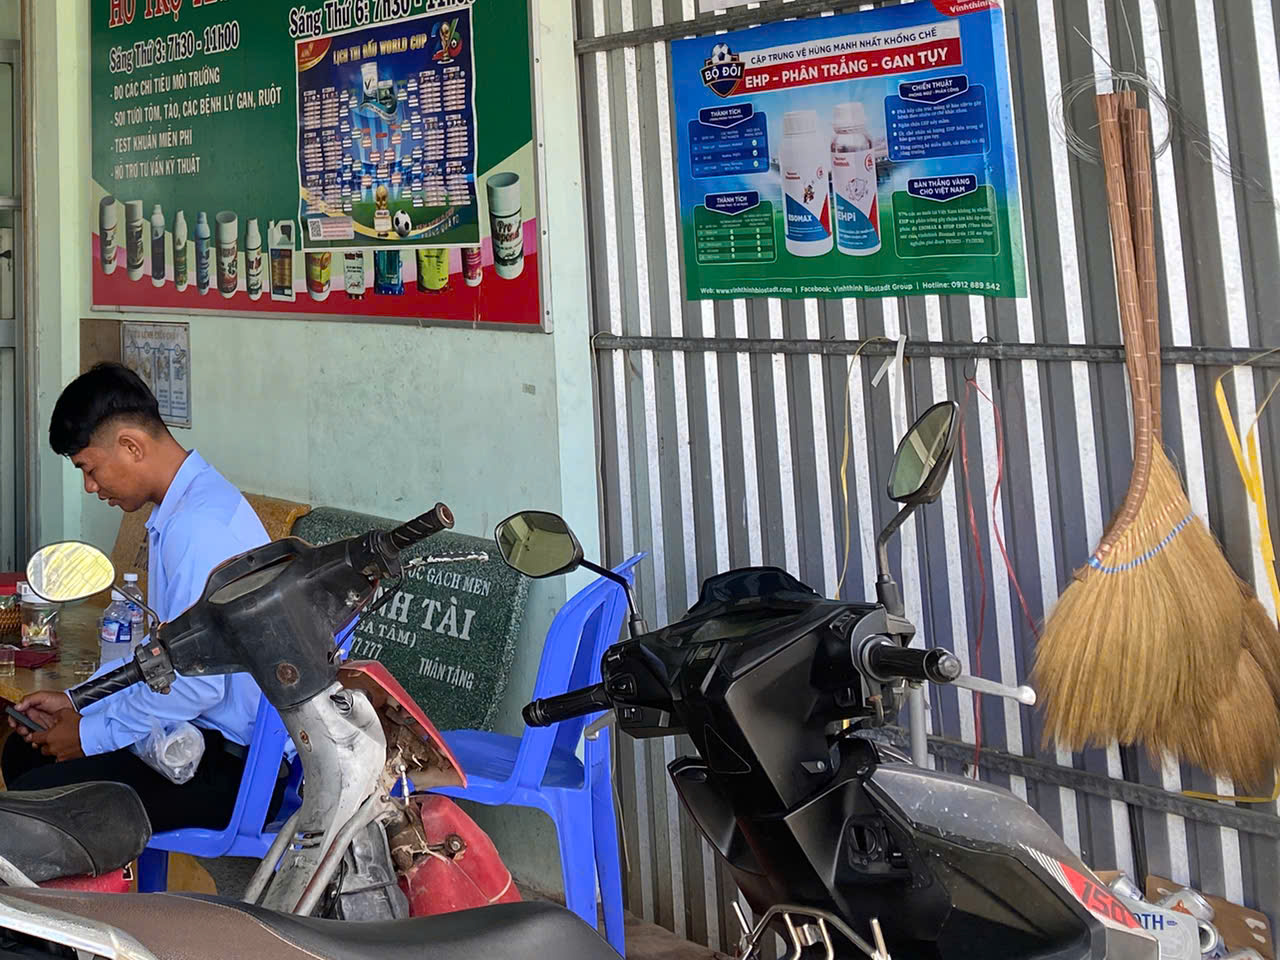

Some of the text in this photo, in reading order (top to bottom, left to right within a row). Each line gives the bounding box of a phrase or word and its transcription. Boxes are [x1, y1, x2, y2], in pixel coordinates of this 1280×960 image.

[289, 6, 322, 38] Sáng
[109, 20, 240, 74] Sáng Thứ 3: 7h30 11h00
[379, 37, 408, 55] WORLD
[410, 33, 428, 50] CUP
[769, 51, 794, 62] TRUNG
[834, 41, 857, 53] MẠNH
[859, 35, 881, 48] NHẤT
[884, 31, 916, 45] KHỐNG
[919, 26, 937, 39] CHẾ
[704, 67, 720, 82] BỘ
[745, 47, 948, 89] EHP PHÂN TRẮNG GAN TỤY
[183, 96, 198, 117] CÁC
[199, 94, 221, 119] BỆNH
[223, 91, 234, 112] LÝ
[236, 91, 256, 110] GAN,
[258, 83, 282, 108] RUỘT
[115, 136, 131, 153] TEST
[892, 283, 913, 291] Group
[923, 281, 950, 289] Hotline:
[421, 596, 476, 640] TÀI
